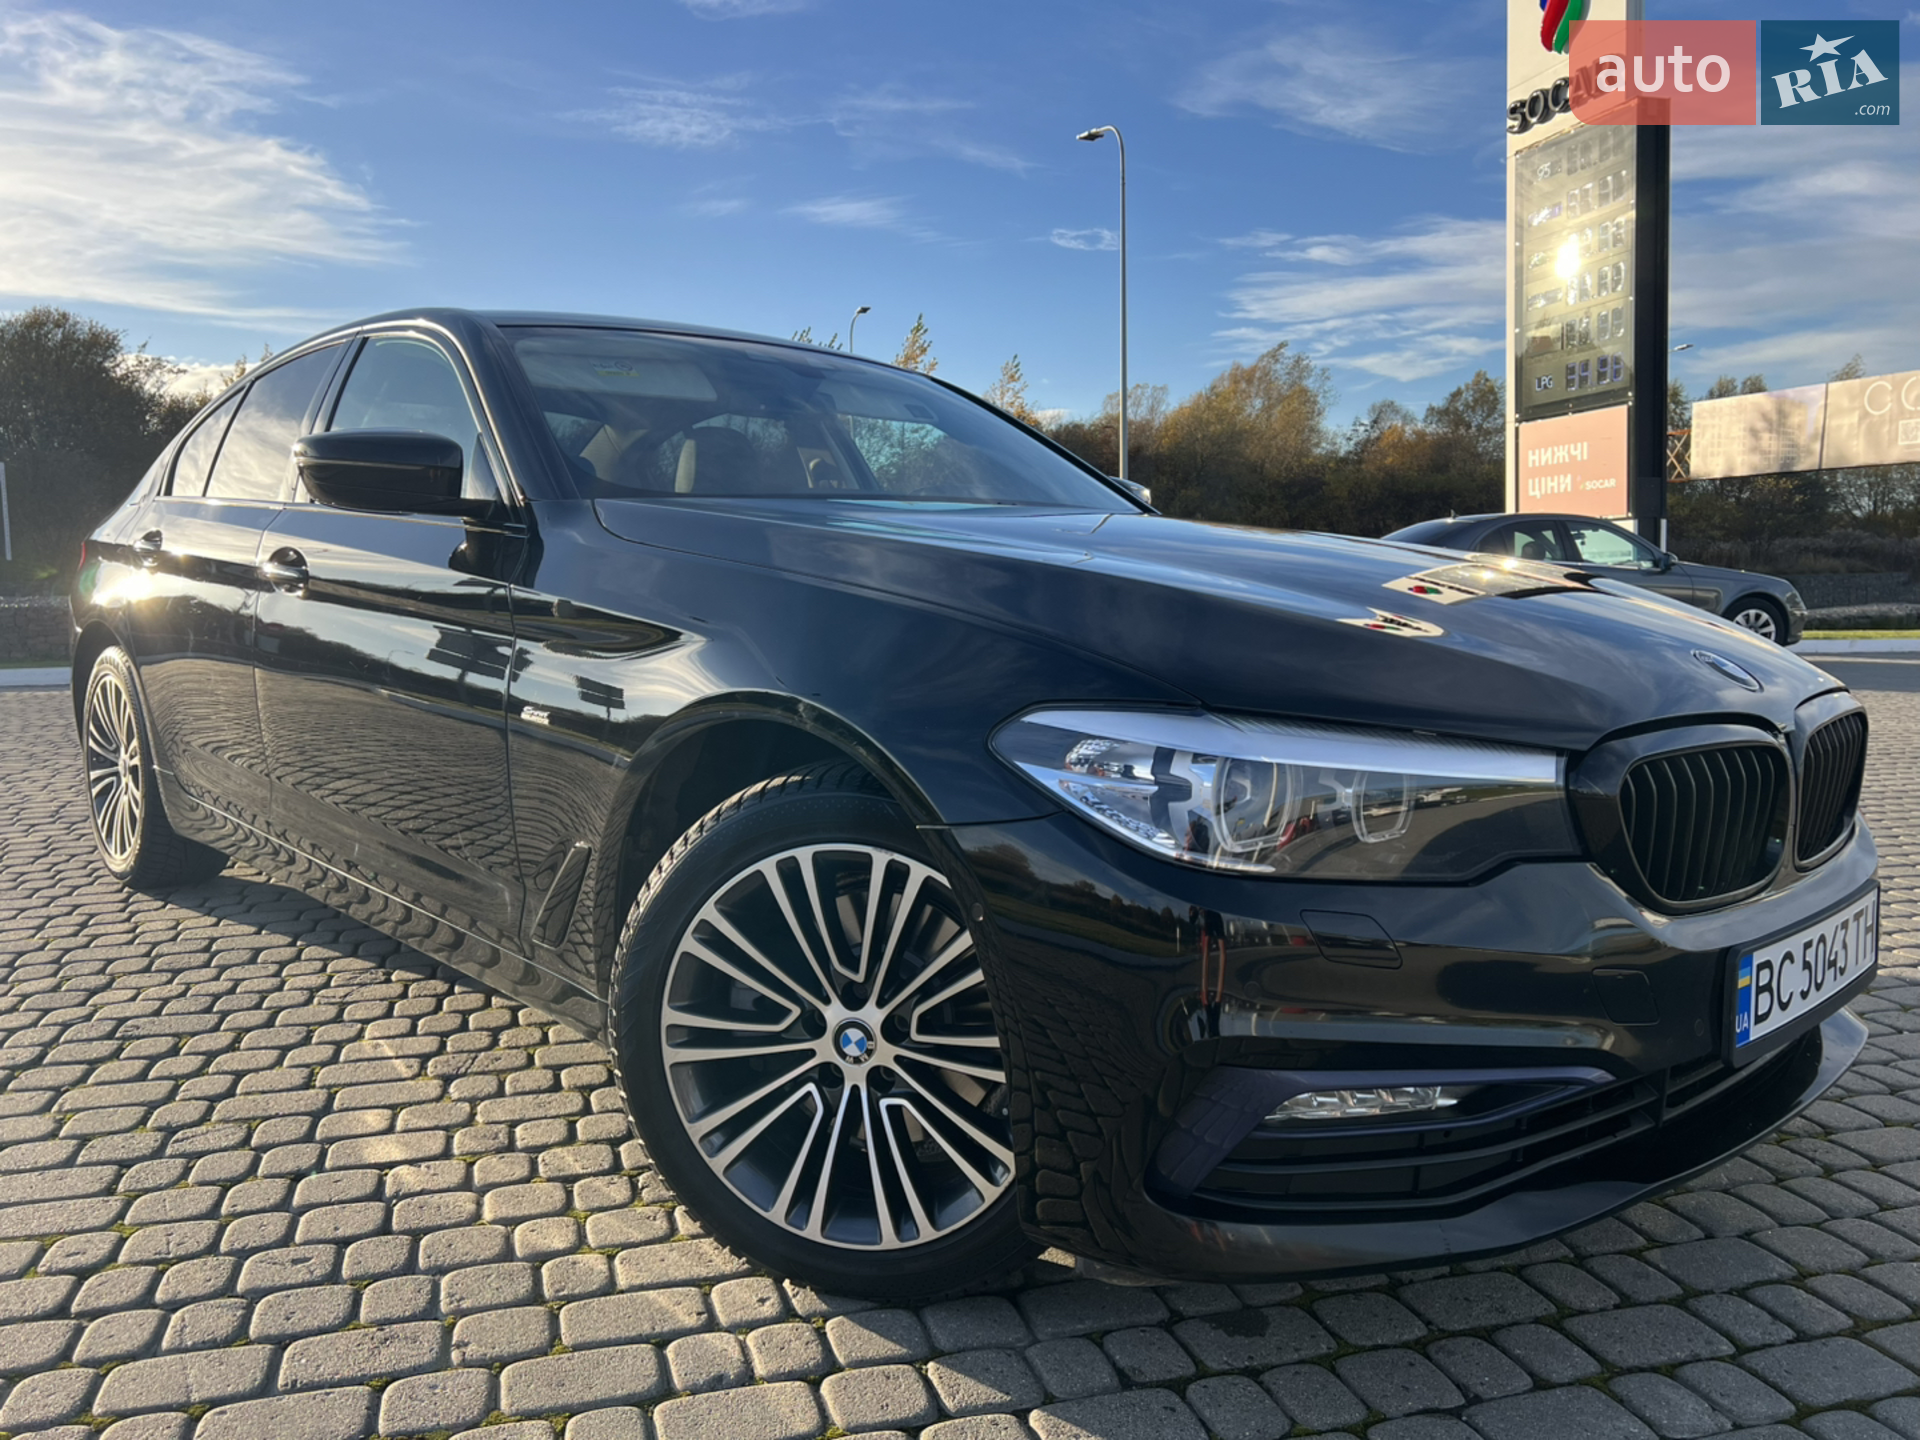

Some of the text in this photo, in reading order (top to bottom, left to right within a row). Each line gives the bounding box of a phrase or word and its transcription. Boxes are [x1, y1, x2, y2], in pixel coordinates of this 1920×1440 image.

[1535, 375, 1553, 392] LPG
[1528, 441, 1588, 468] НИЖЧІ
[1528, 473, 1572, 499] ЦІНИ
[1585, 478, 1617, 491] SOCAR
[1754, 901, 1877, 1026] BC 5043 TH
[1735, 1012, 1749, 1034] UA
